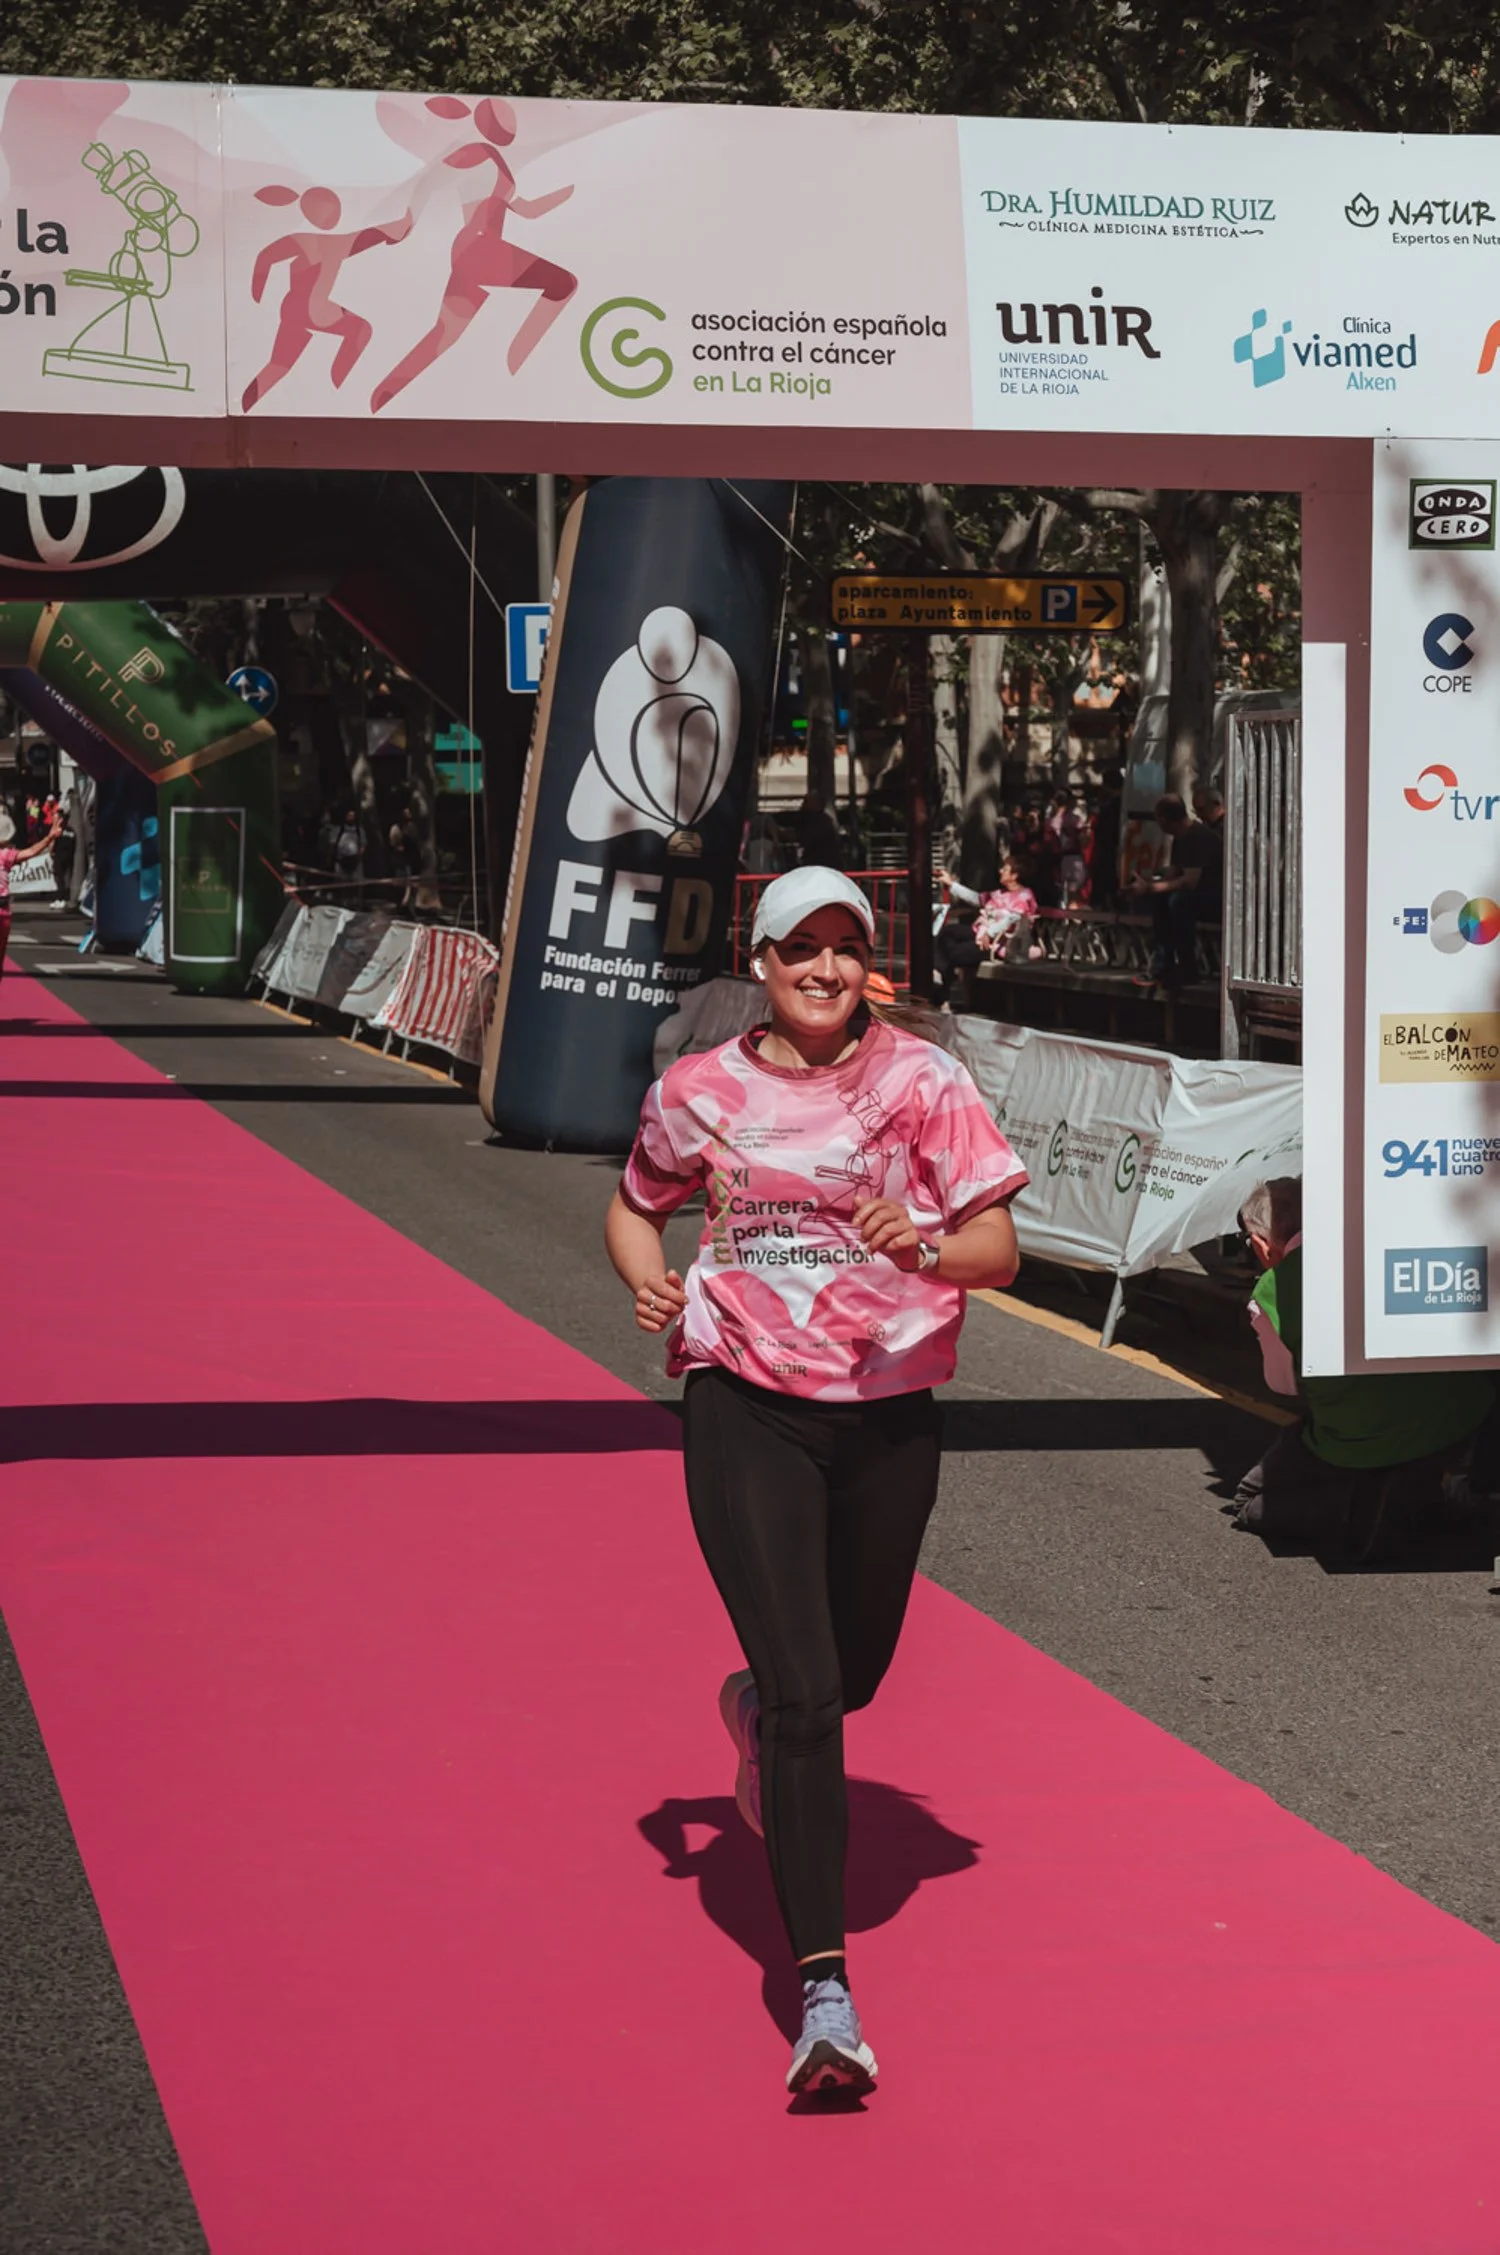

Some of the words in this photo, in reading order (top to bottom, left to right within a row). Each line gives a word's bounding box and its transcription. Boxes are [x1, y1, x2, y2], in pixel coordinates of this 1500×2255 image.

[1049, 187, 1204, 219] HUMILDAD
[1211, 198, 1277, 225] RUIZ
[17, 208, 68, 254] la
[1027, 219, 1089, 234] CLÍNICA
[1094, 222, 1167, 236] MEDICINA
[1172, 224, 1239, 238] ESTÉTICA
[1392, 232, 1450, 246] Expertos
[1453, 235, 1469, 244] en
[691, 310, 825, 333] asociación
[833, 314, 947, 340] española
[1343, 316, 1391, 334] Clínica
[692, 341, 774, 363] contra
[782, 342, 802, 363] el
[810, 342, 896, 366] cáncer
[998, 351, 1088, 365] UNIVERSIDAD
[1293, 334, 1416, 368] viamed
[1000, 367, 1109, 381] INTERNACIONAL
[1346, 371, 1396, 391] Alxen
[693, 373, 724, 393] en
[732, 372, 762, 394] La
[769, 372, 832, 400] Rioja
[1000, 382, 1018, 394] DE
[1021, 383, 1039, 395] LA
[1042, 383, 1080, 396] RIOJA
[1423, 496, 1481, 510] ONDA
[1427, 519, 1480, 535] CERO
[838, 585, 973, 601] aparcamiento:
[838, 604, 887, 622] plaza
[900, 605, 1032, 623] Ayuntamiento
[1047, 587, 1070, 620] P
[1423, 675, 1472, 693] COPE
[56, 633, 177, 757] PITILLOS
[548, 859, 713, 955] FFD
[544, 945, 646, 978] Fundación
[540, 971, 586, 993] para
[596, 980, 617, 998] el
[626, 982, 678, 1006] Depo
[1384, 1034, 1394, 1046] EL
[1396, 1022, 1471, 1045] BALCÓN
[1434, 1050, 1446, 1061] DE
[1447, 1045, 1499, 1062] MATEO
[1452, 1138, 1500, 1150] nueve
[1382, 1139, 1448, 1177] 941
[730, 1168, 749, 1188] XI
[1452, 1164, 1484, 1176] uno
[1149, 1181, 1175, 1200] Rioja
[729, 1196, 815, 1216] Carrera
[732, 1225, 769, 1245] por
[773, 1221, 794, 1239] la
[1393, 1258, 1420, 1293] El
[1427, 1260, 1481, 1292] Día
[1424, 1293, 1438, 1304] de
[1440, 1292, 1453, 1304] La
[1456, 1291, 1482, 1306] Rioja
